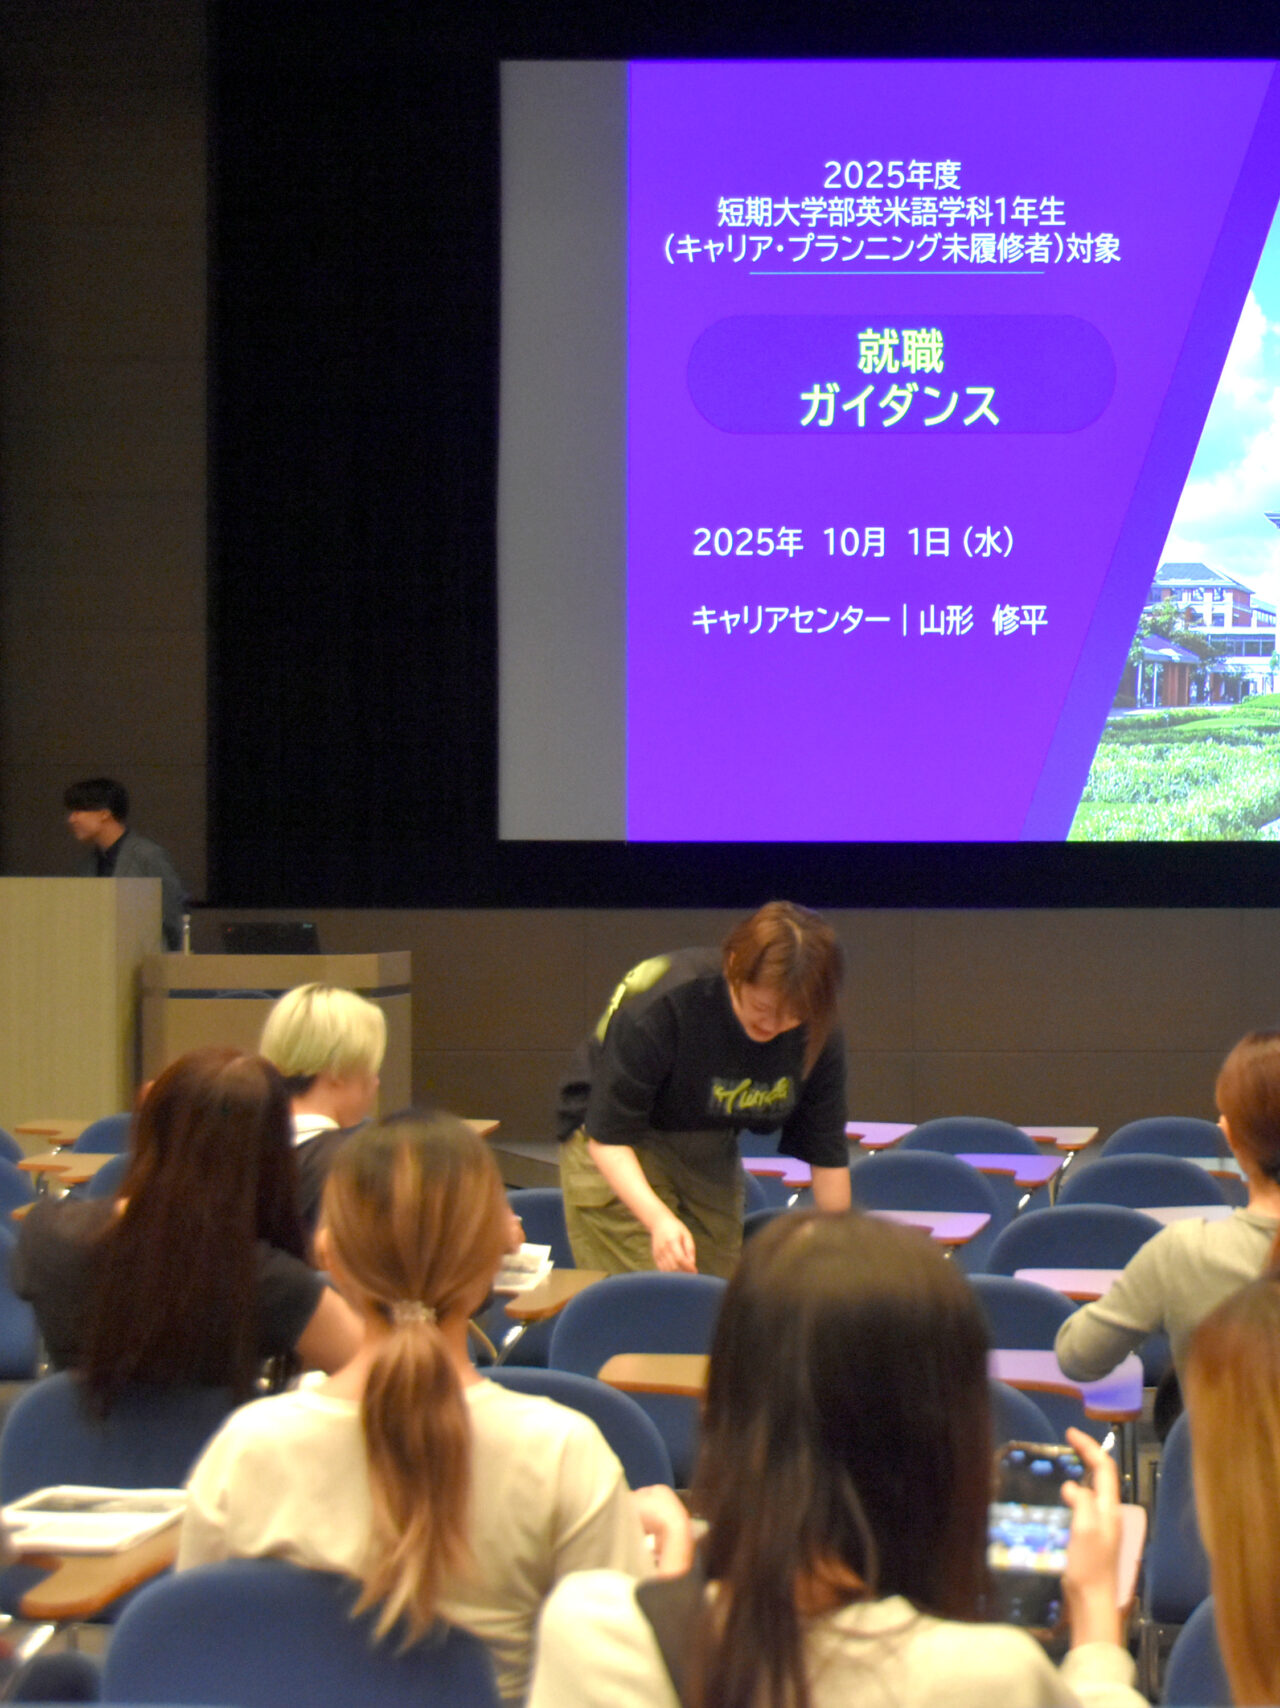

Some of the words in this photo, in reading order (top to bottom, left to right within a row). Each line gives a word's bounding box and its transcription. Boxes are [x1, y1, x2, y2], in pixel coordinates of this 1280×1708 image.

[823, 158, 962, 191] 2025年度
[717, 195, 1067, 228] 短期大学部英米語学科1年生
[664, 231, 1122, 265] （キャリア・プランニング未履修者）対象
[857, 327, 945, 375] 就職
[799, 381, 1000, 428] ガイダンス
[692, 525, 804, 558] 2025年
[823, 526, 885, 558] 10月
[991, 603, 1049, 636] 修平
